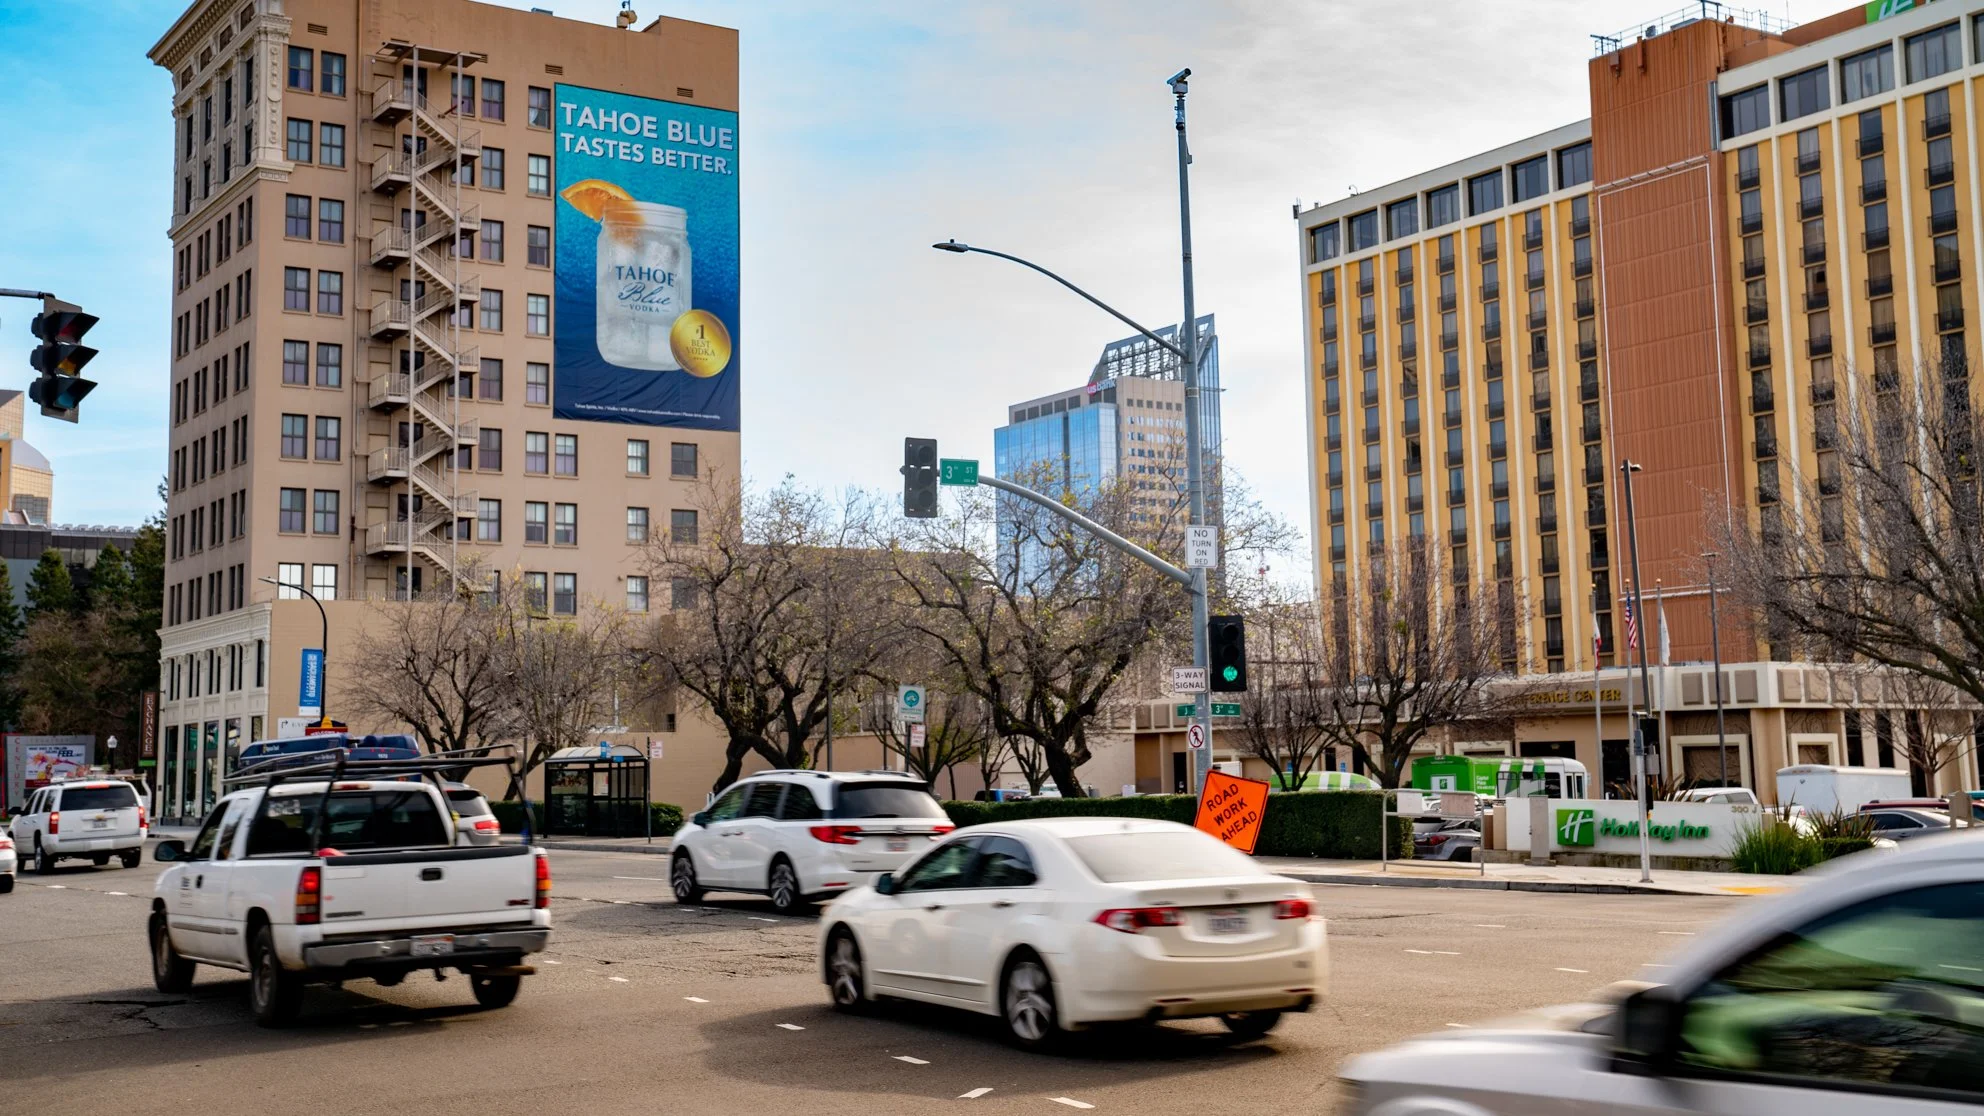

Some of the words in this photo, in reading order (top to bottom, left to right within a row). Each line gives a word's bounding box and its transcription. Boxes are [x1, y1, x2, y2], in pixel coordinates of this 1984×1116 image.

[560, 102, 658, 139] TAHOE
[667, 119, 733, 150] BLUE
[560, 132, 645, 163] TASTES
[651, 148, 732, 175] BETTER.
[616, 265, 675, 287] TAHOE
[618, 281, 671, 305] Blue
[629, 304, 660, 313] VODKA
[691, 339, 711, 348] BEST
[685, 346, 716, 357] VODKA
[965, 466, 973, 474] ST
[1194, 529, 1208, 538] NO
[1175, 671, 1204, 679] 3-WAY
[1175, 681, 1205, 689] SIGNAL
[145, 697, 154, 752] EXCHANGE
[57, 749, 75, 758] FEEL
[1206, 784, 1239, 811] ROAD
[1213, 797, 1248, 826] WORK
[1731, 805, 1749, 813] 300
[1752, 806, 1757, 814] J
[1221, 811, 1257, 842] AHEAD
[1679, 819, 1709, 838] Inn
